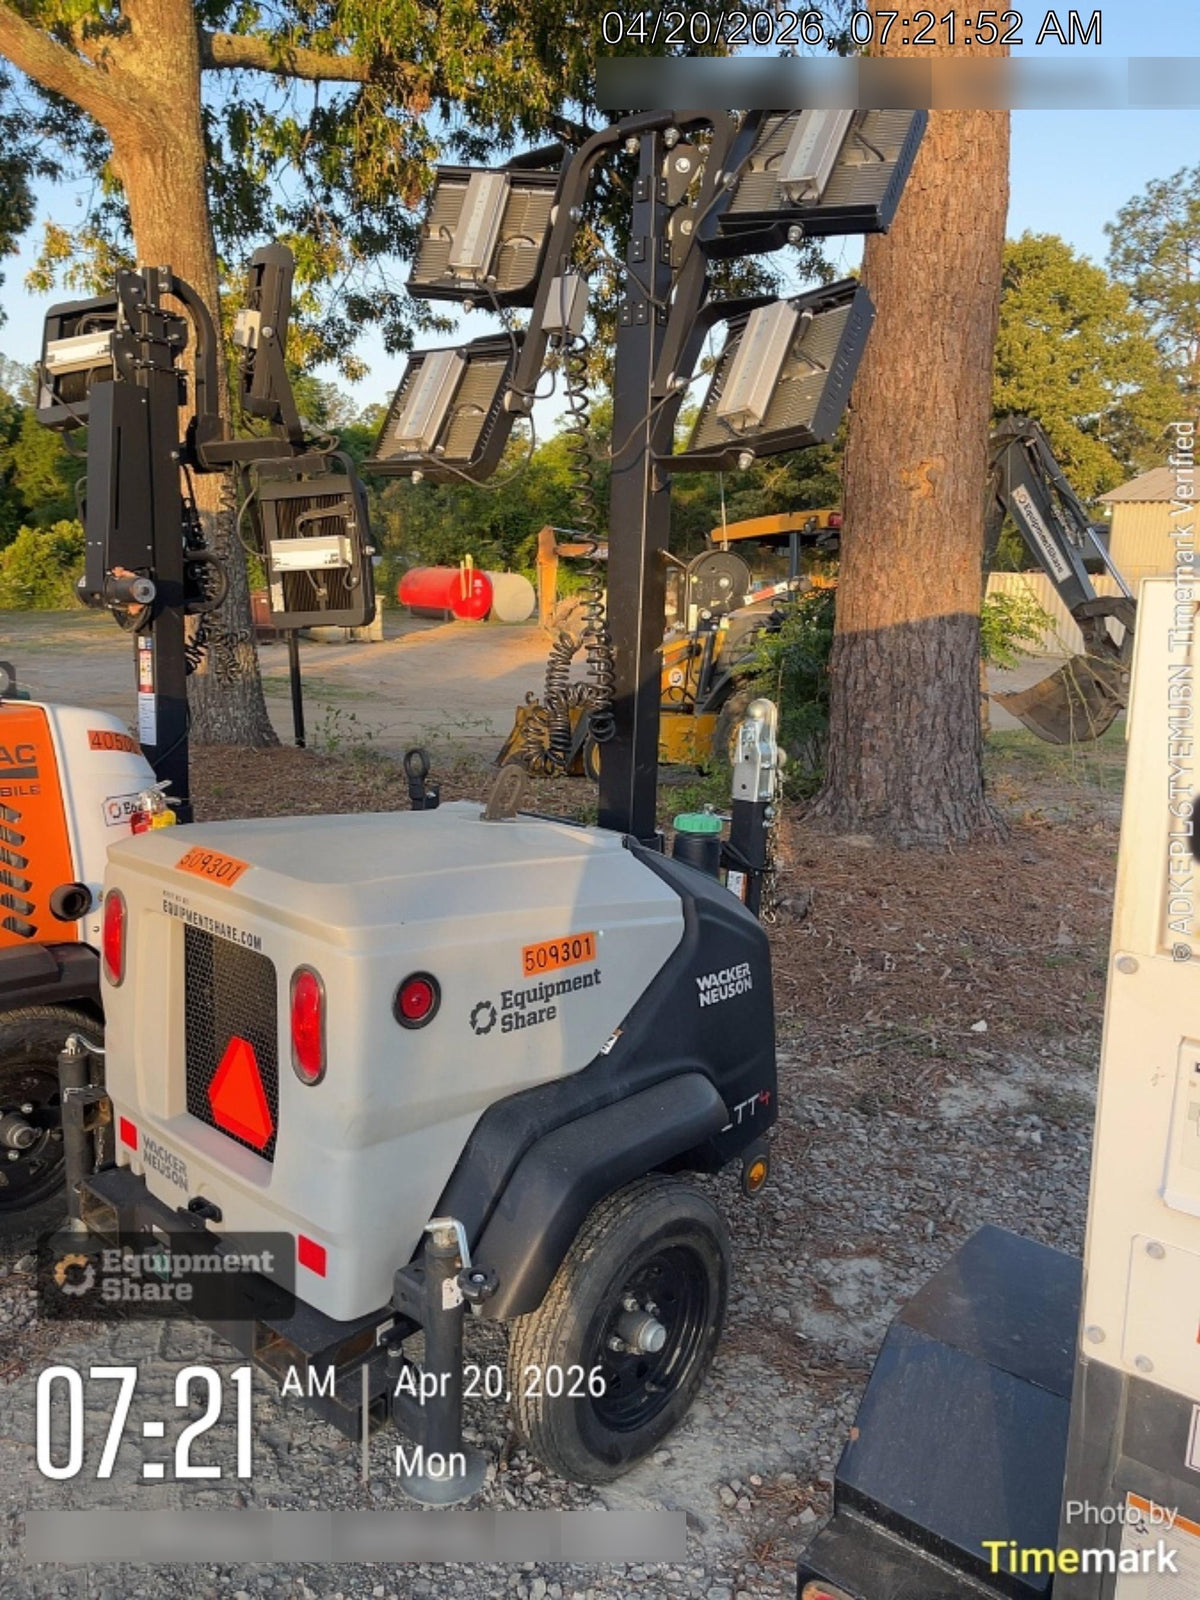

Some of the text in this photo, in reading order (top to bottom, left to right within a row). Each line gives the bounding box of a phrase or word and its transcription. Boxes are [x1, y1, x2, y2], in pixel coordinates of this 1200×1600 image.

[162, 899, 263, 951] EQUIPMENTSHARE.COM
[525, 938, 591, 972] 509301
[501, 968, 602, 1010] Equipment
[696, 962, 751, 991] WACKER
[699, 976, 752, 1007] NEUSON
[501, 1005, 557, 1034] Share
